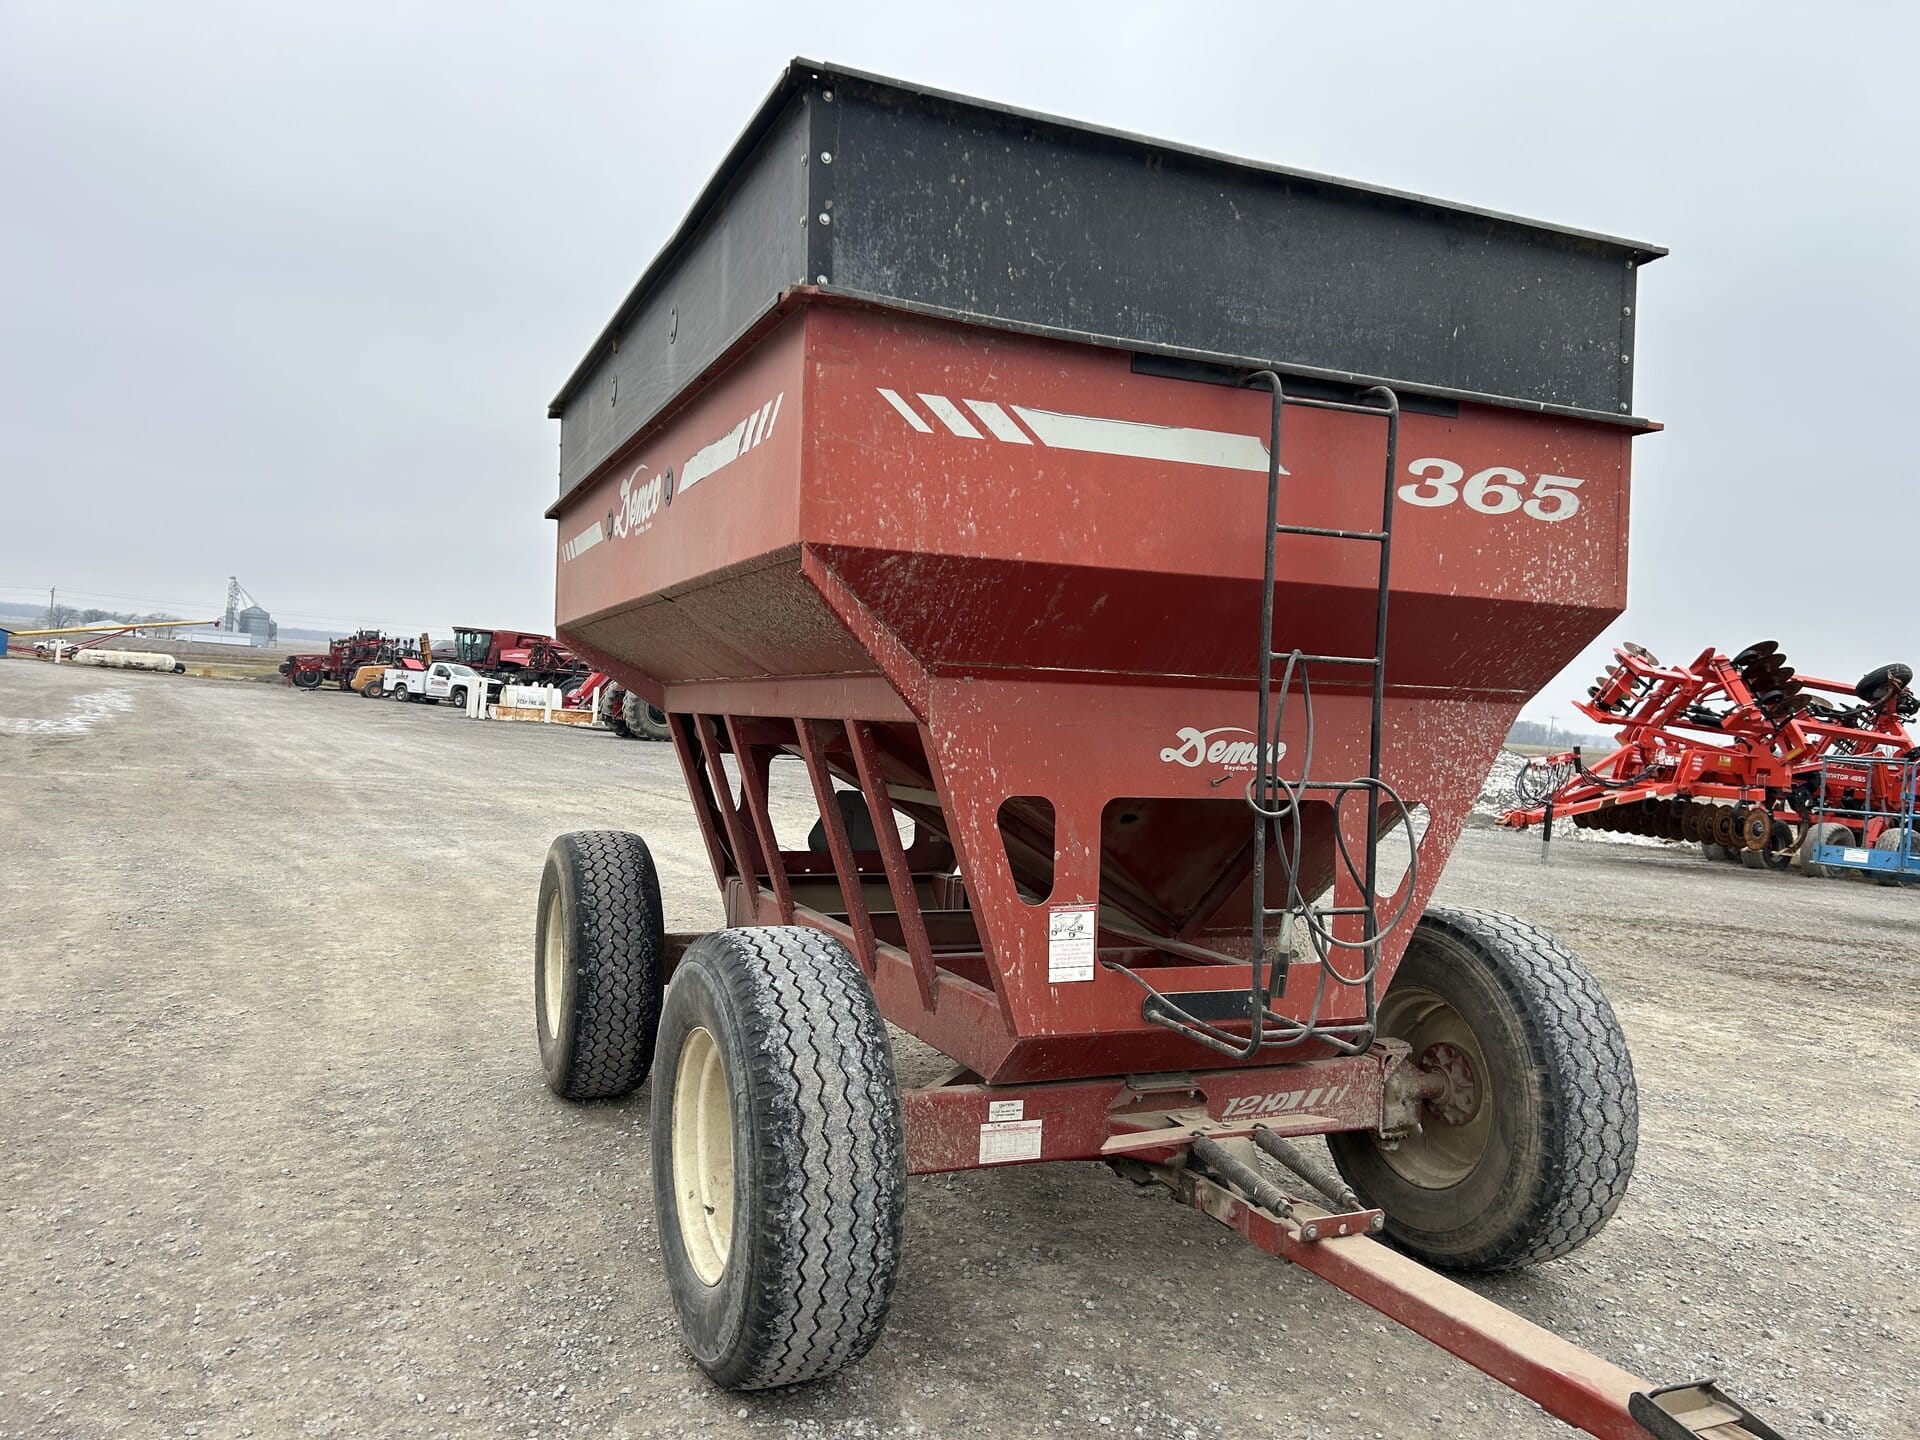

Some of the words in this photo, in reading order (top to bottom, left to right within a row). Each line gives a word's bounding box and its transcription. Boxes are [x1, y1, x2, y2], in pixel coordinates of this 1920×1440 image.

[614, 464, 661, 539] Demco
[1397, 457, 1585, 522] 365
[1272, 1108, 1305, 1116] Running
